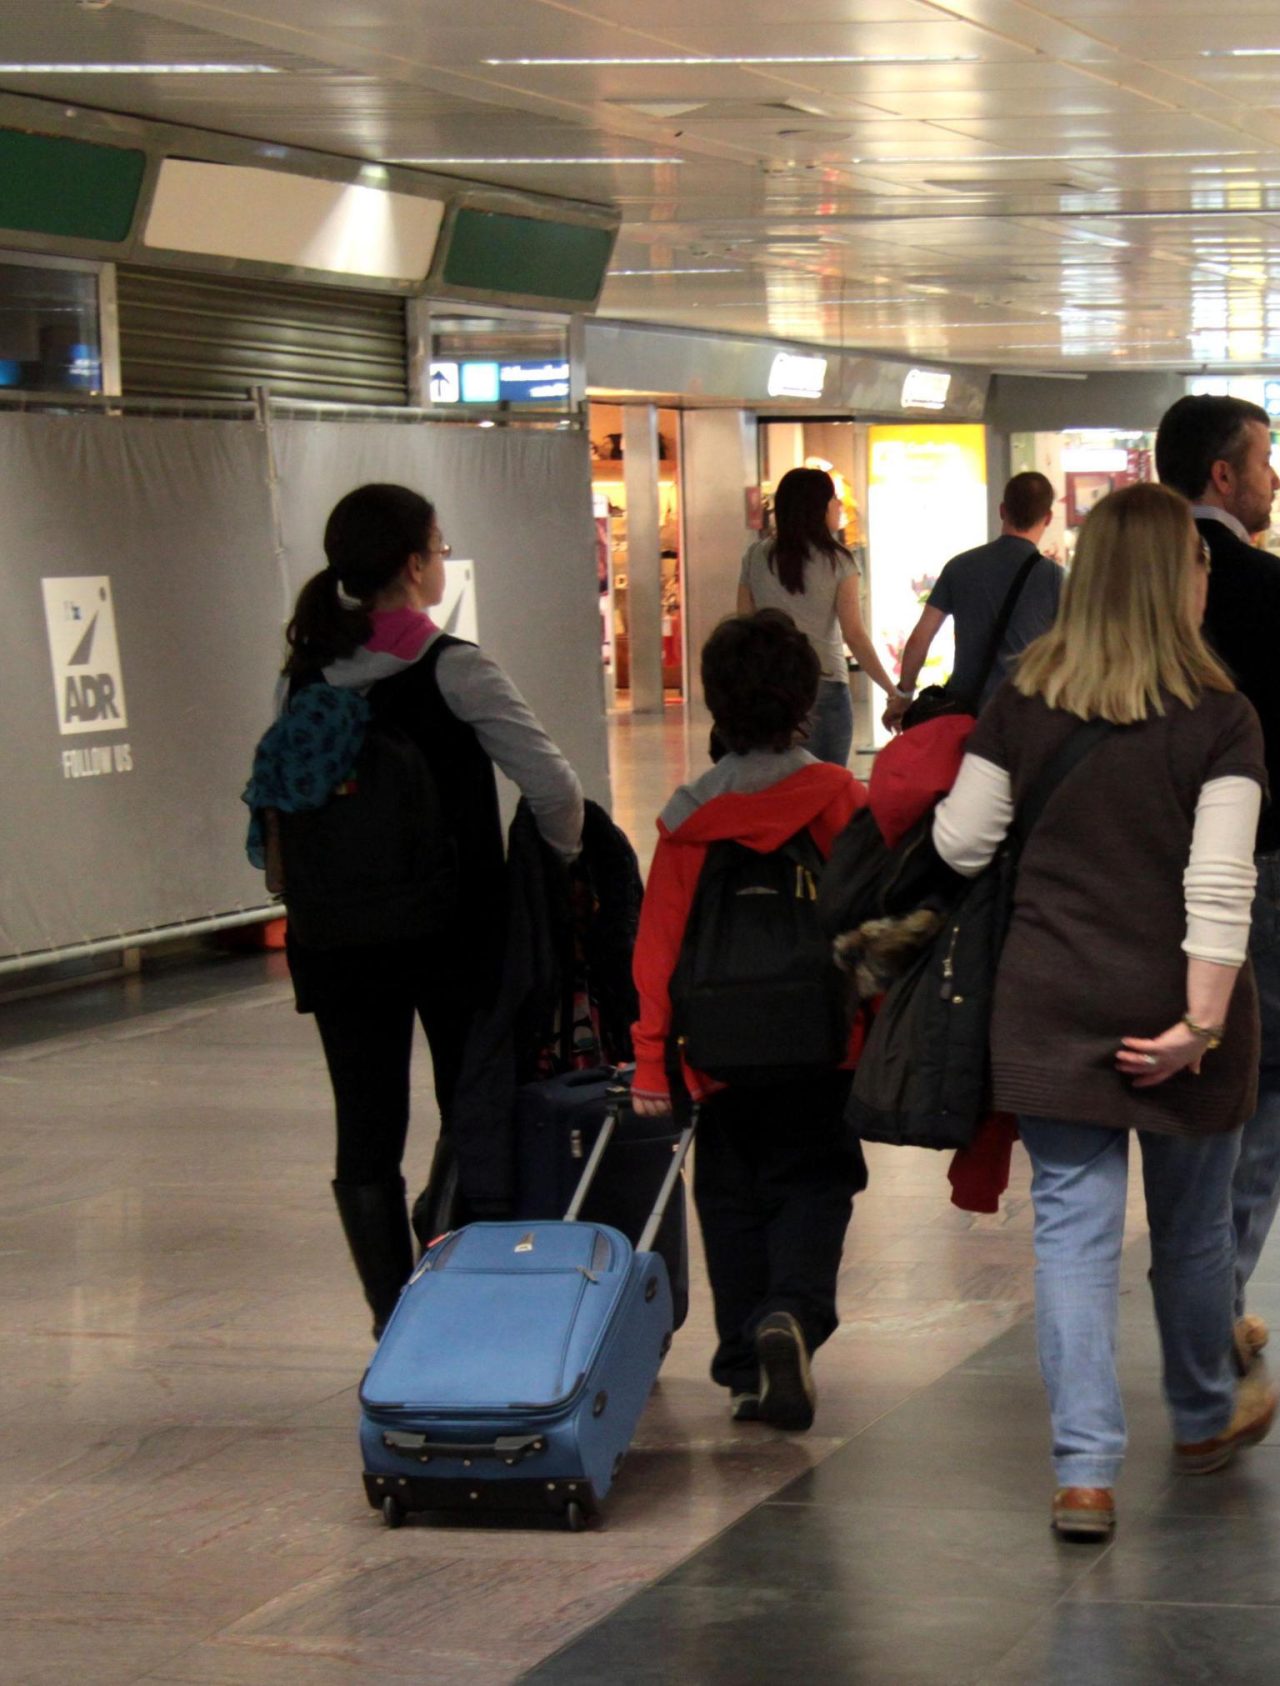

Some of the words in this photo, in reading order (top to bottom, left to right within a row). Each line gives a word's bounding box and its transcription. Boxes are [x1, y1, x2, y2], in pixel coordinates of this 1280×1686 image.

[64, 673, 120, 723] ADR
[62, 746, 112, 778] FOLLOW
[113, 744, 133, 772] US
